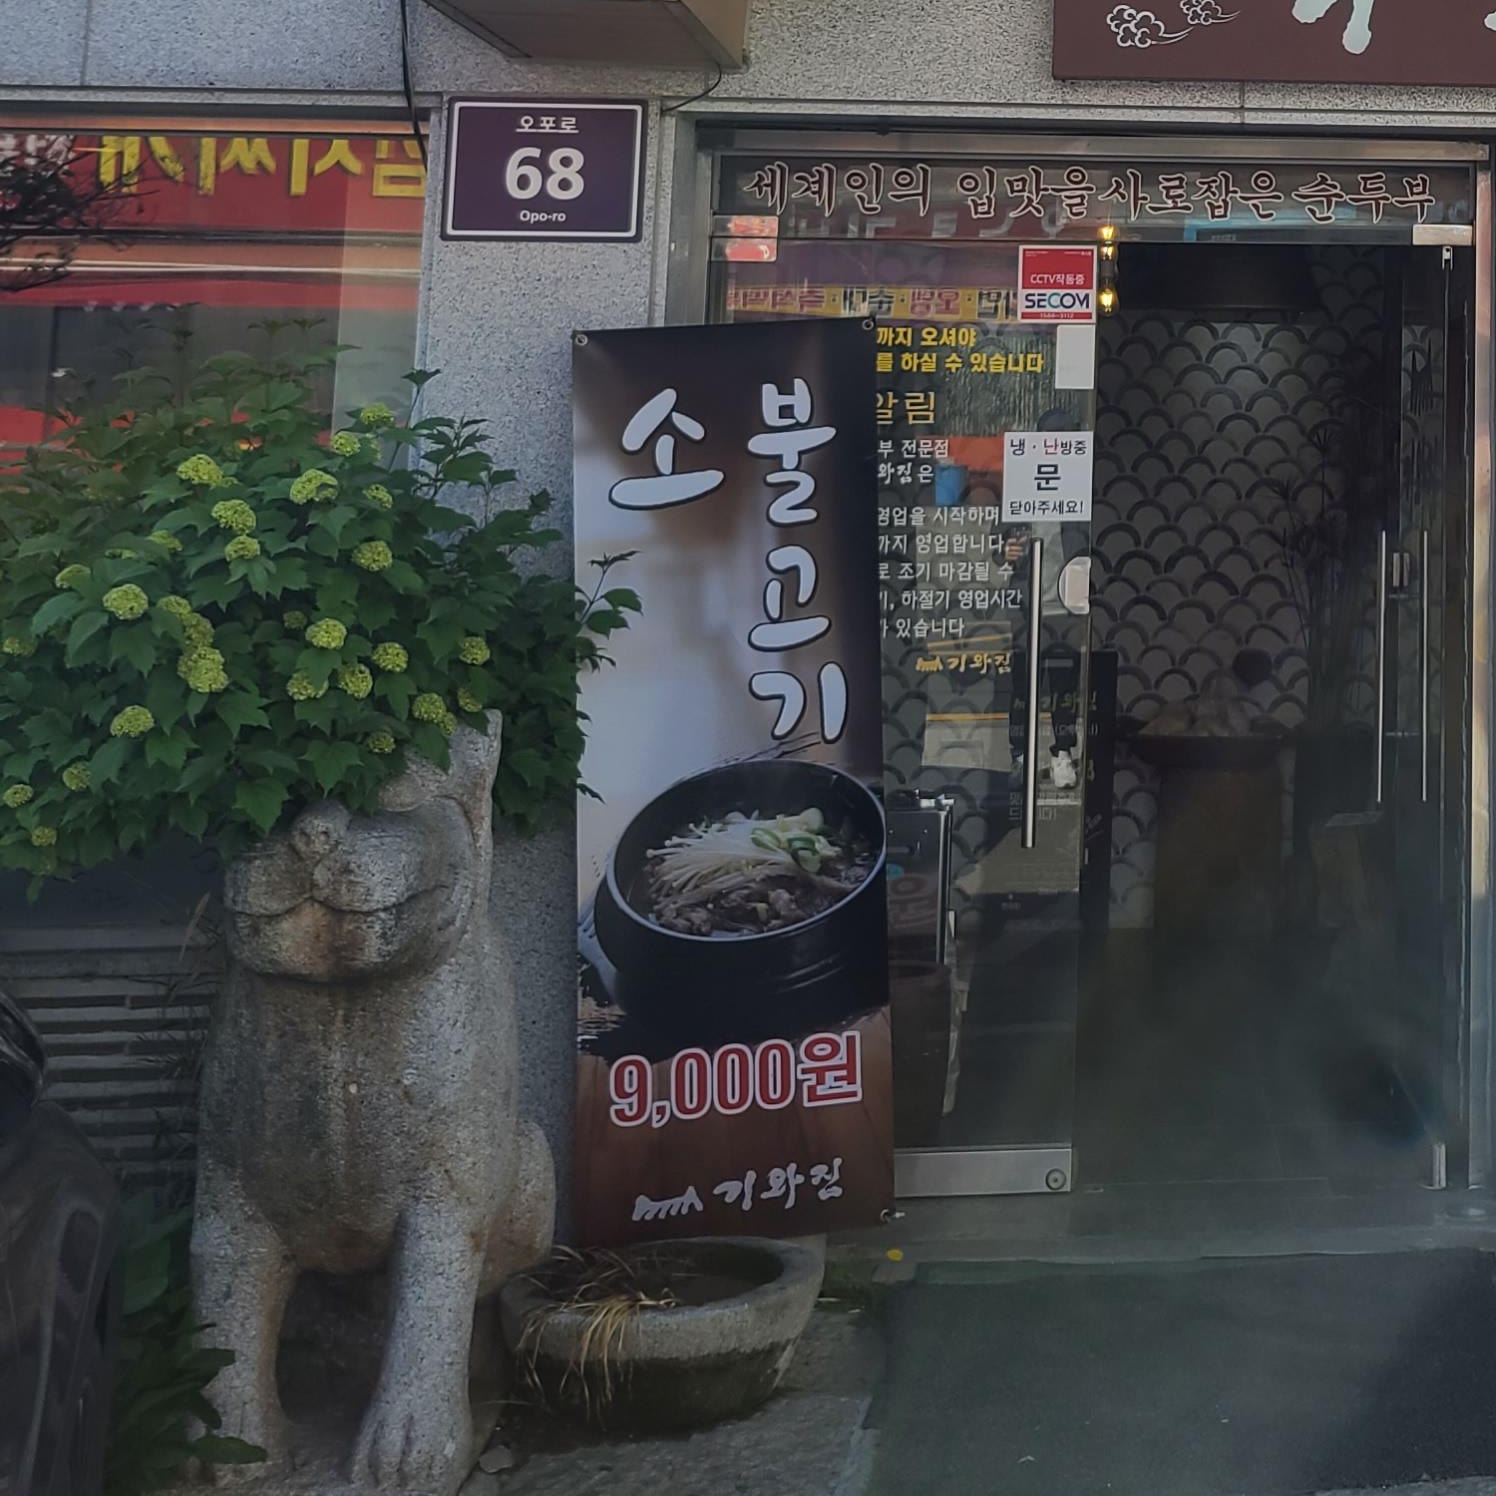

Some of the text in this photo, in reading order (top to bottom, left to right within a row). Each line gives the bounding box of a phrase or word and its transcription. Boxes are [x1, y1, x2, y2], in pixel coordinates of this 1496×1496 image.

[516, 114, 580, 133] 오포로
[505, 146, 586, 201] 68
[744, 161, 932, 217] 세계인의
[1291, 172, 1436, 224] 순두부
[519, 209, 567, 224] Opo-ro
[1030, 273, 1086, 286] CCTV작동중
[1024, 292, 1090, 310] SECOM
[920, 327, 977, 347] 오셔야
[876, 352, 1044, 373] 를 하실 수 있습니다
[901, 439, 949, 459] 전문점
[1034, 464, 1061, 491] 문
[933, 506, 999, 526] 시작하며
[1010, 500, 1084, 515] 닫아주세요!
[608, 377, 848, 744] 소 불고기
[898, 562, 930, 582] 조기
[939, 561, 989, 581] 마감될
[998, 561, 1014, 580] 수
[901, 590, 949, 610] 하절기
[958, 589, 1022, 609] 영업시간
[896, 617, 965, 638] 있습니다
[946, 652, 1013, 674] 기와집
[609, 1029, 863, 1129] 9,000원
[712, 1157, 843, 1211] 기와집
